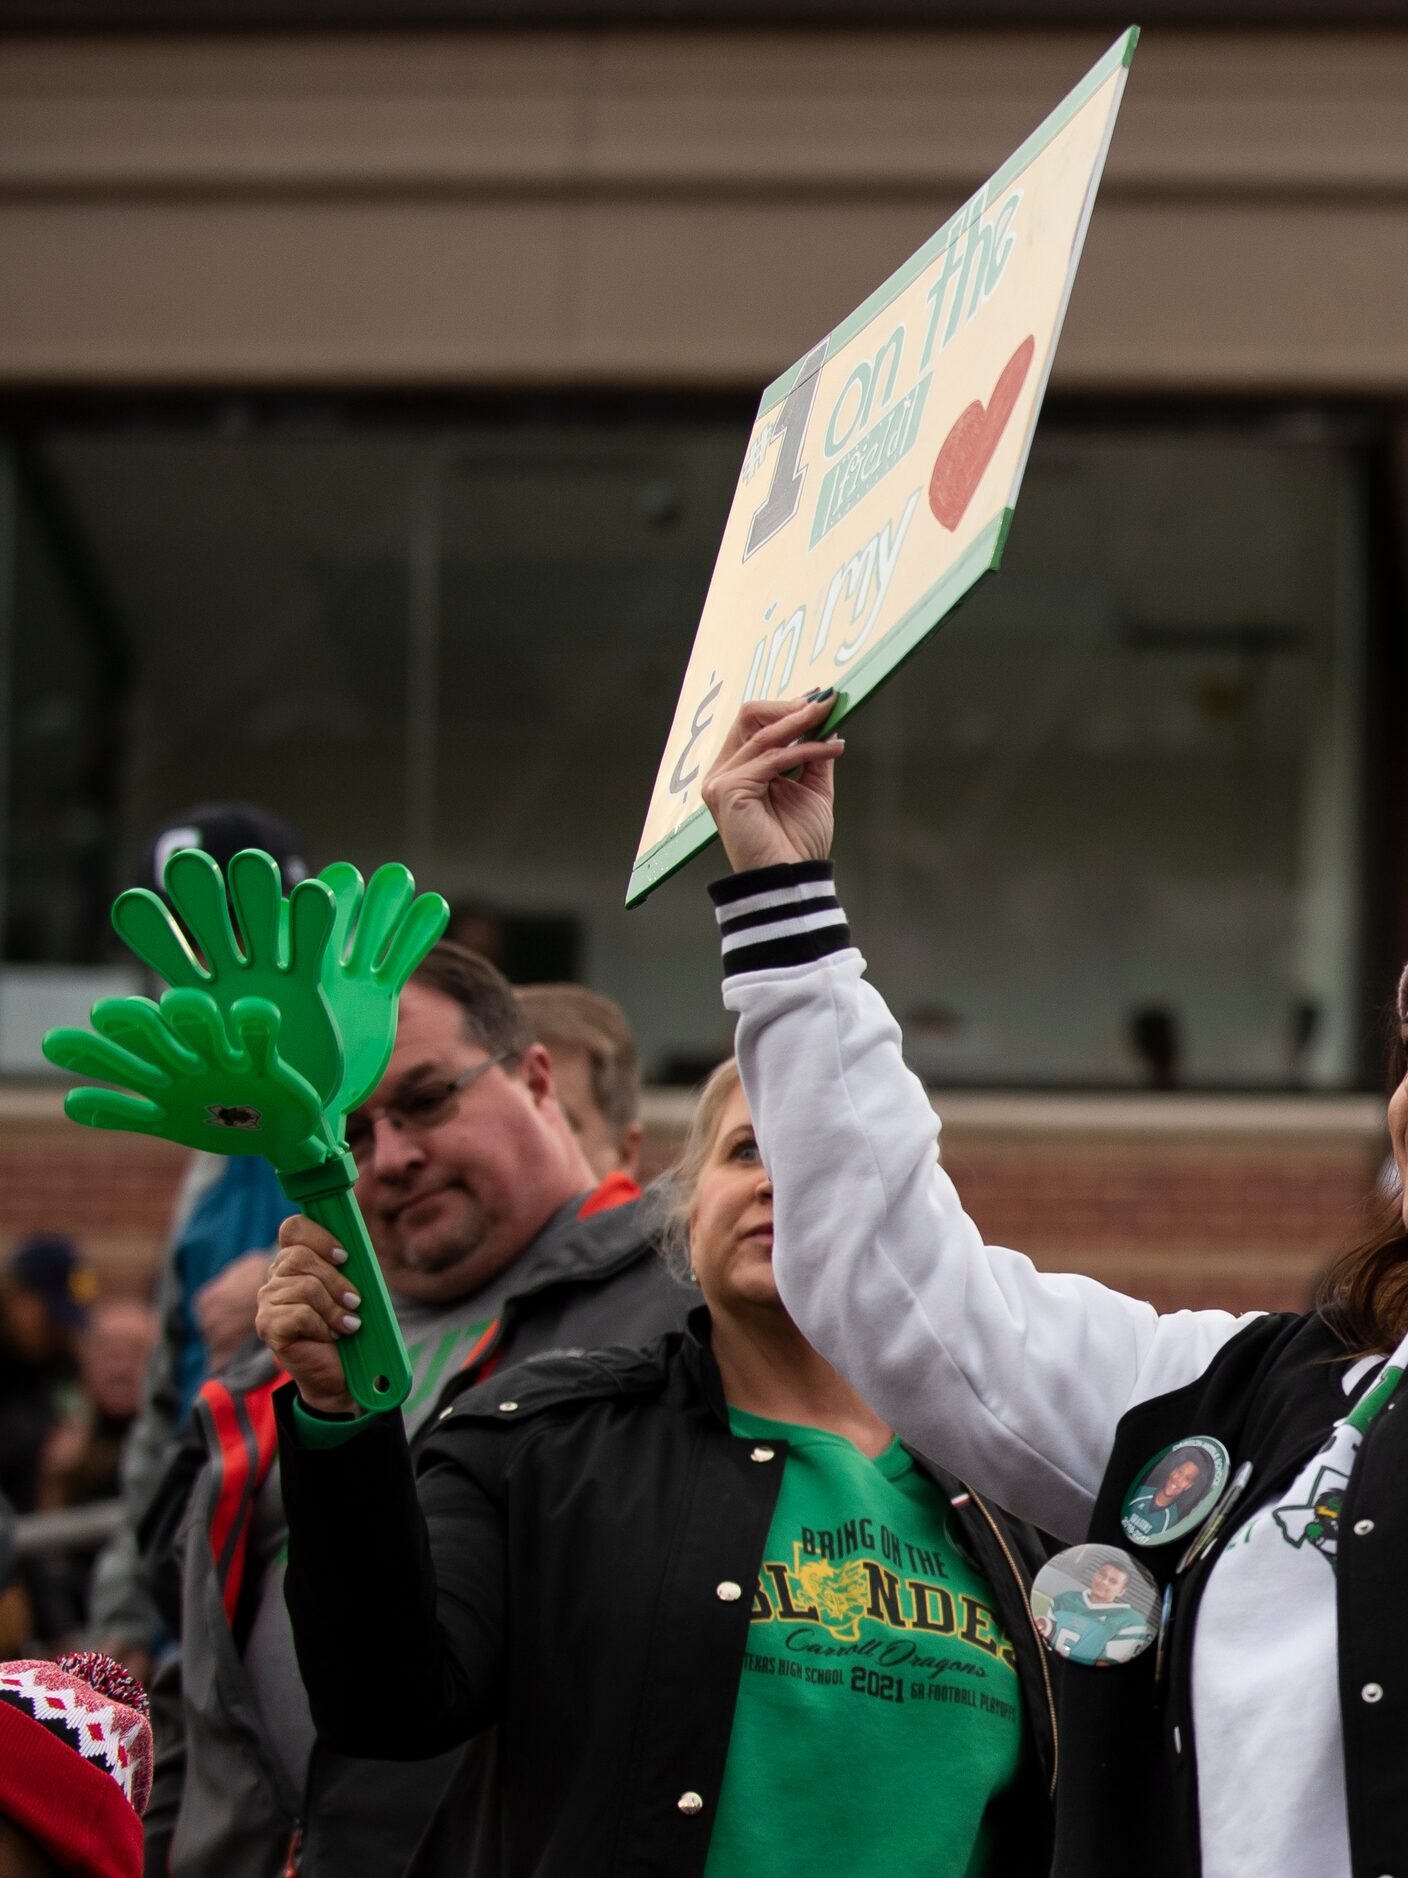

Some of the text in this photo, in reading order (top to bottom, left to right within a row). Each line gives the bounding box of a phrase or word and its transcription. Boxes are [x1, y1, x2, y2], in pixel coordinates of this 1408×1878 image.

[823, 322, 907, 460] on
[918, 181, 1025, 374] the
[743, 600, 807, 704] in
[810, 485, 925, 667] my
[801, 1518, 949, 1579] BRING ON THE
[743, 1653, 775, 1675] TEXAS
[778, 1657, 802, 1680] HIGH
[804, 1667, 844, 1685] SCHOOL
[850, 1665, 905, 1704] 2021
[928, 1682, 977, 1708] FOOTBALL
[980, 1693, 1017, 1723] PLAYOFFS
[785, 1628, 989, 1679] Carroll Dragons
